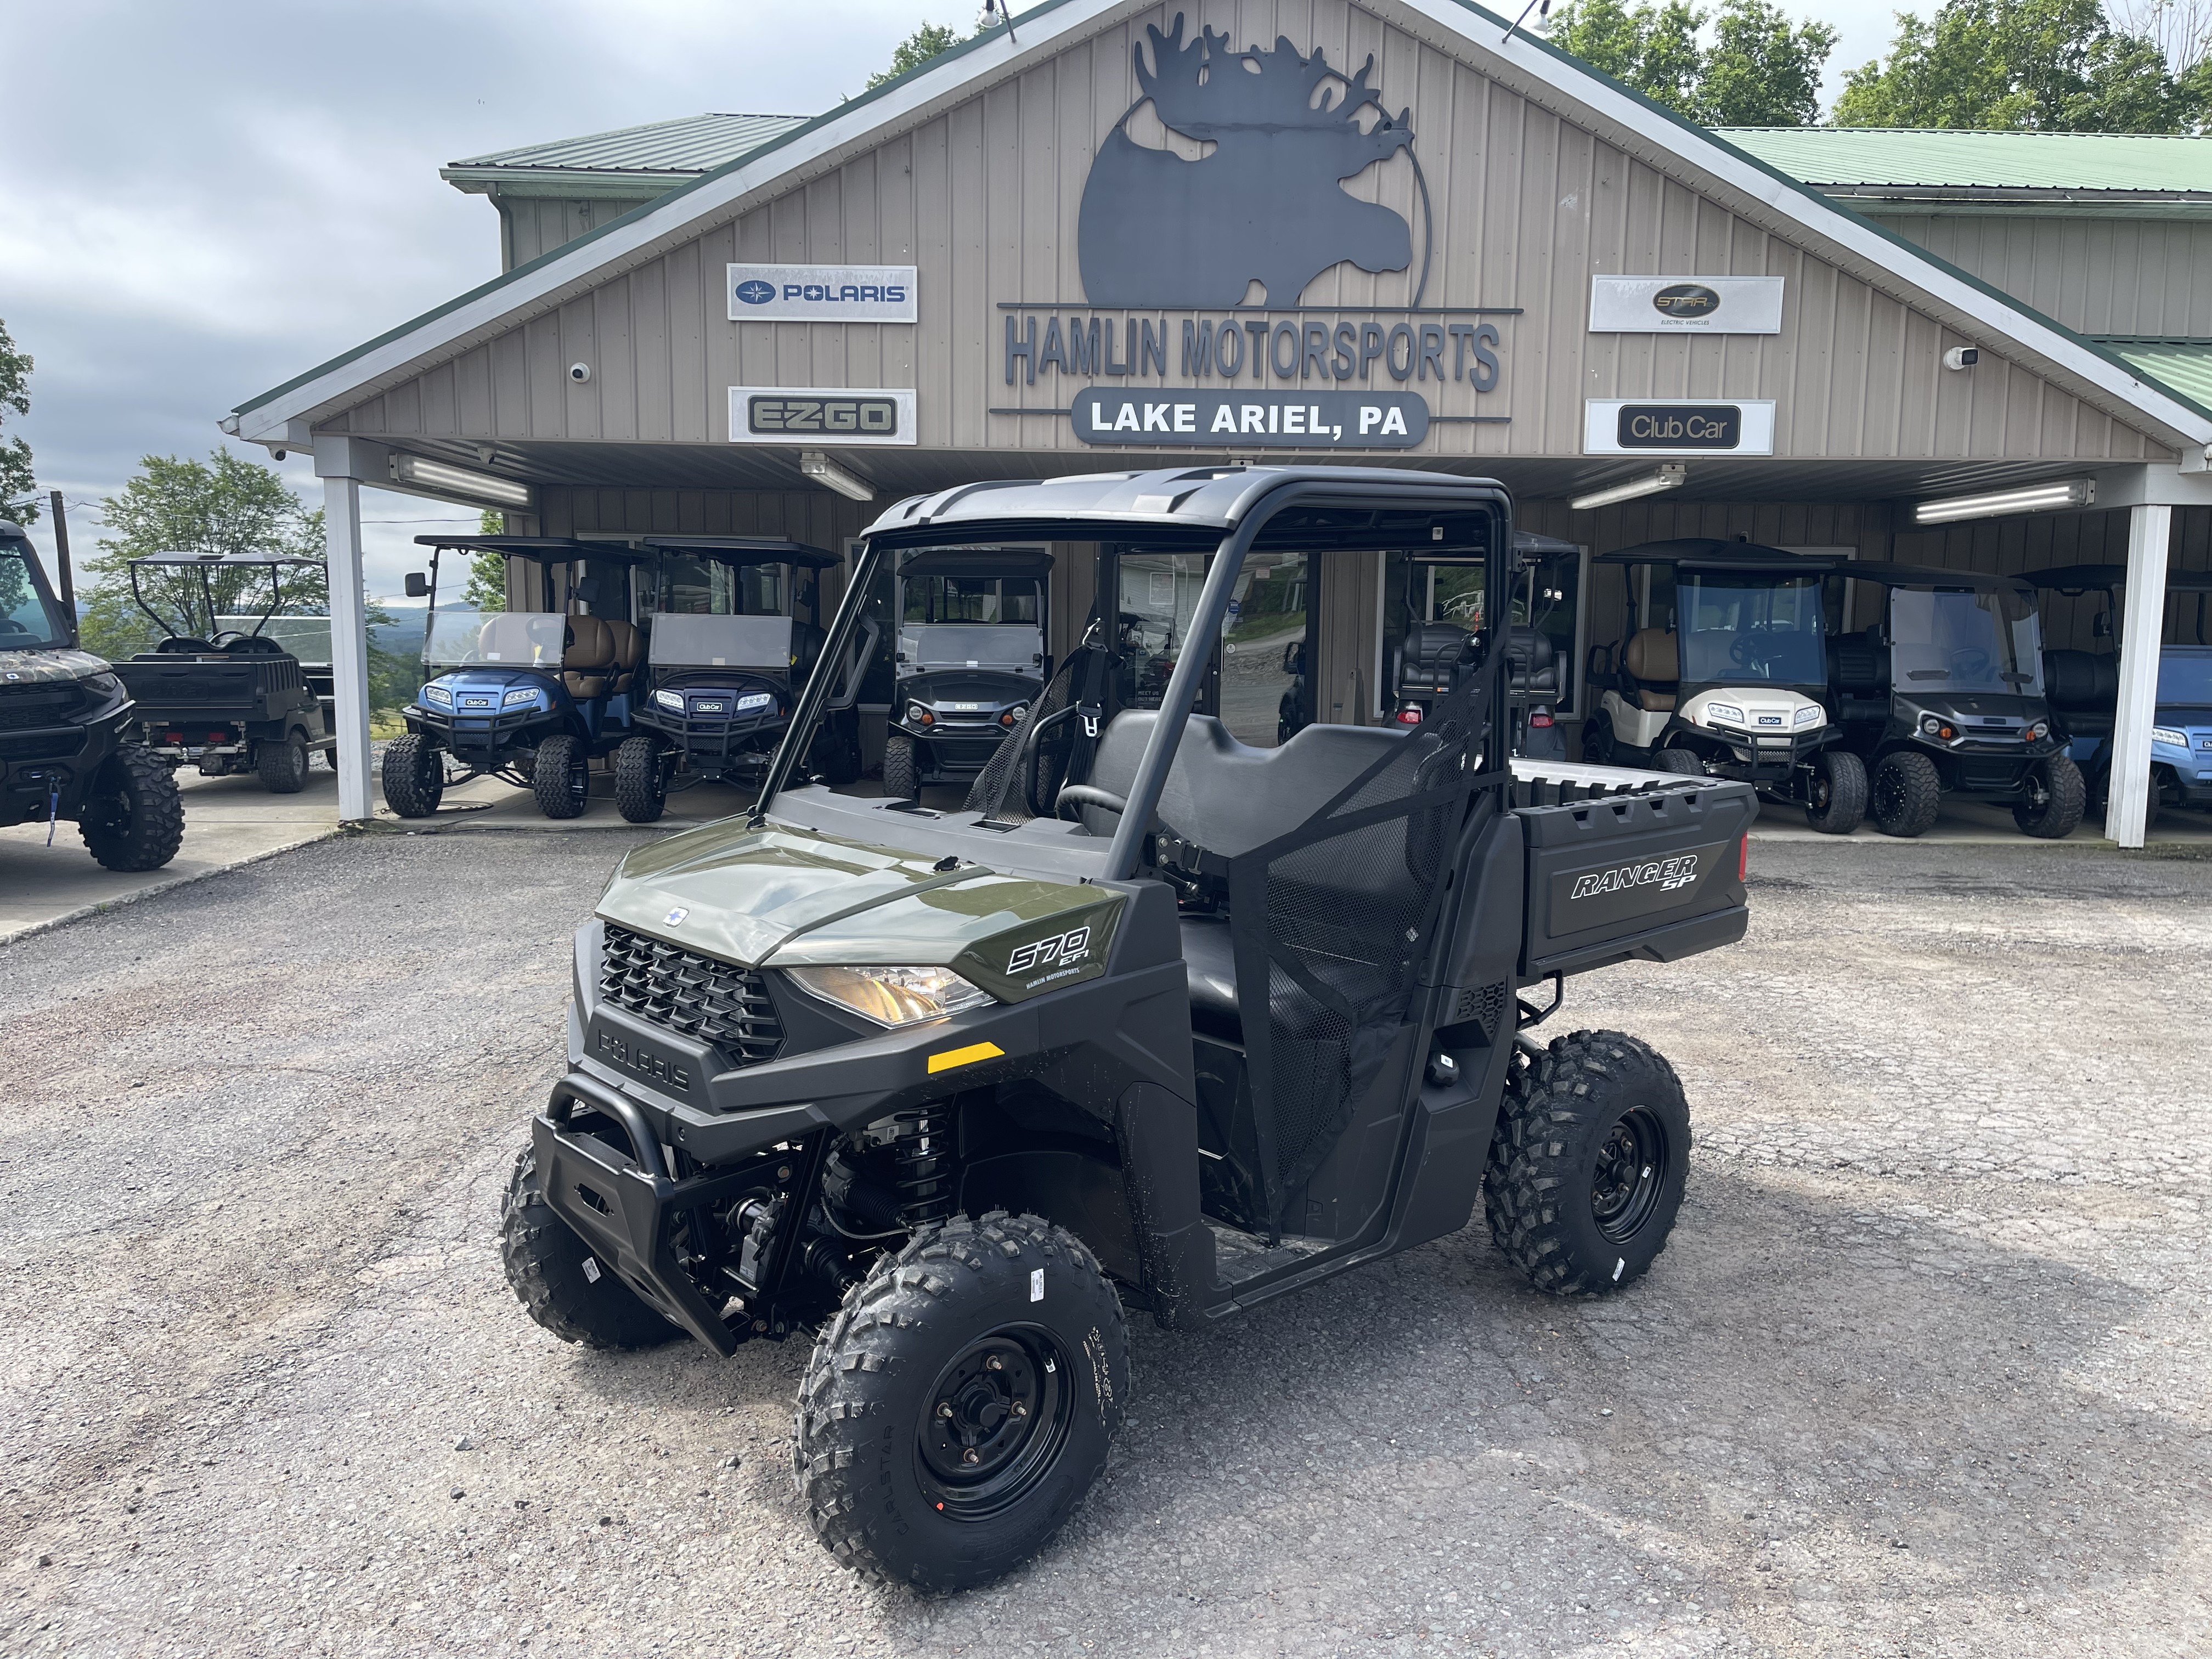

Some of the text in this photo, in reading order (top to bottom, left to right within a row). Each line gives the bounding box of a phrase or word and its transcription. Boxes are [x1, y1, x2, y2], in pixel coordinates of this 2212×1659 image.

[783, 285, 905, 302] POLARIS
[1657, 296, 1708, 307] STAR
[1006, 315, 1499, 392] HAMLIN MOTORSPORTS
[754, 402, 891, 430] EZGO
[1092, 402, 1408, 441] LAKE ARIEL, PA
[1631, 415, 1728, 439] Club Car
[1571, 854, 1698, 899] RANGER
[1660, 874, 1697, 891] SP
[1006, 926, 1091, 975] 570
[1059, 949, 1090, 967] EFI
[1026, 967, 1080, 990] HAMLIN MOTORSPORTS
[598, 1029, 689, 1092] POLARIS
[880, 1425, 910, 1535] CARLSTAR
